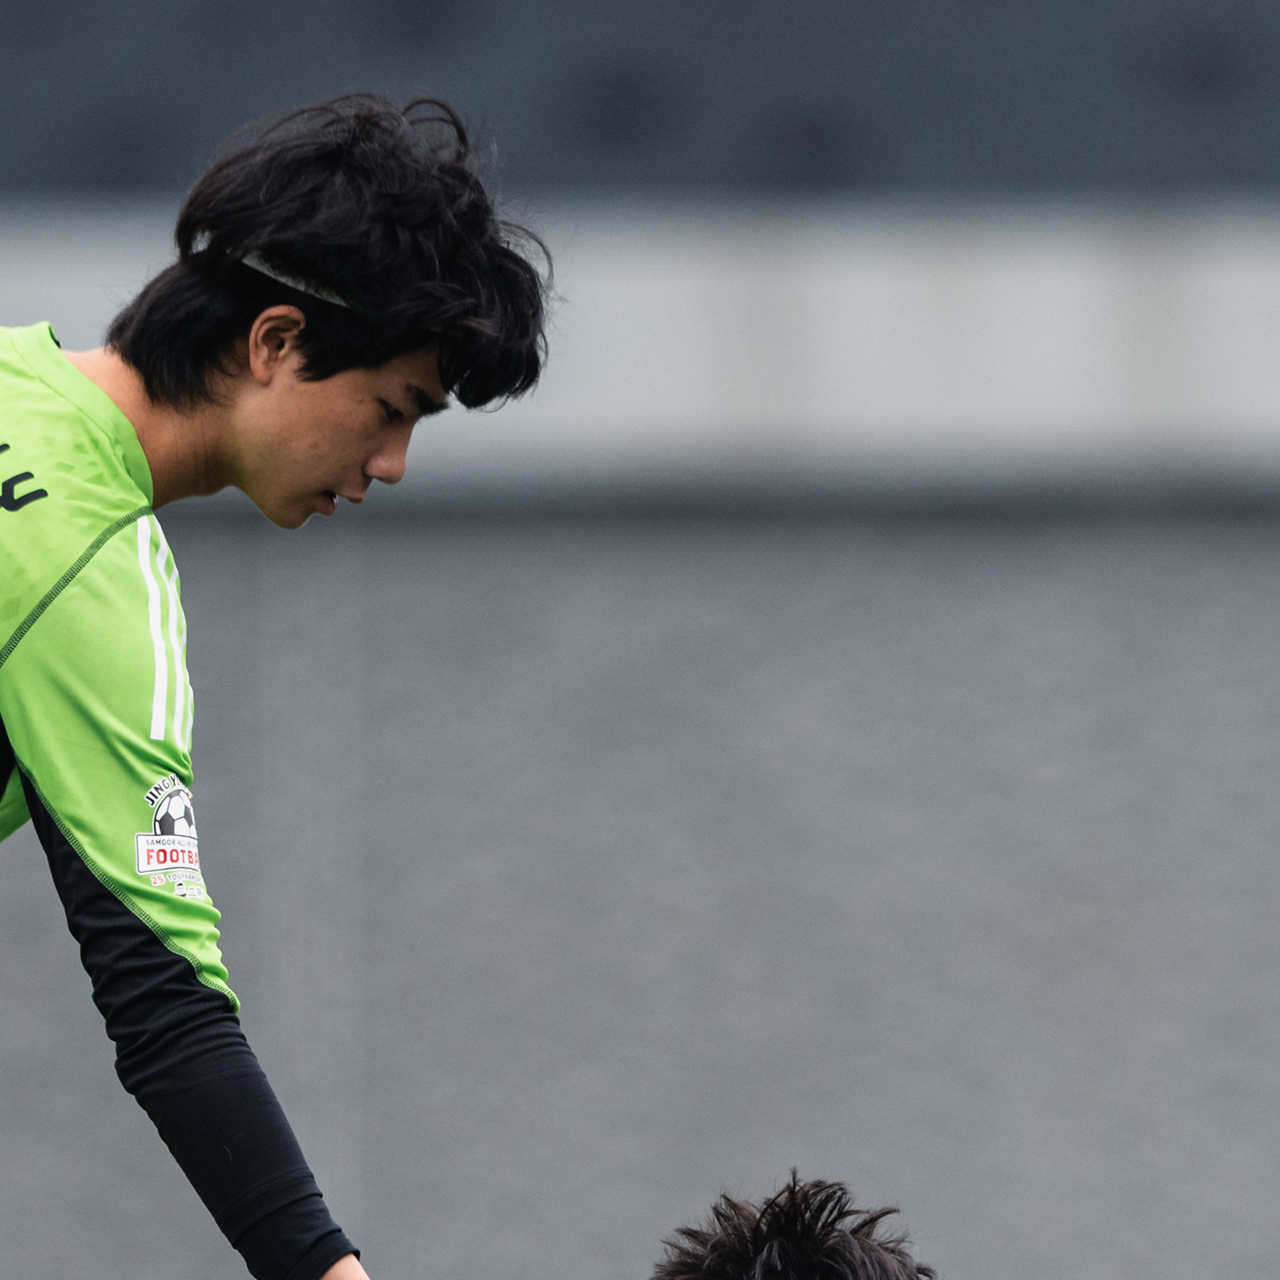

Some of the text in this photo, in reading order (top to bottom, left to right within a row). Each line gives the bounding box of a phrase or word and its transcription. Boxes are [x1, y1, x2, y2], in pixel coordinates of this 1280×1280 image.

[146, 779, 170, 806] JING
[145, 838, 177, 846] SAMGOR
[152, 876, 164, 885] 25
